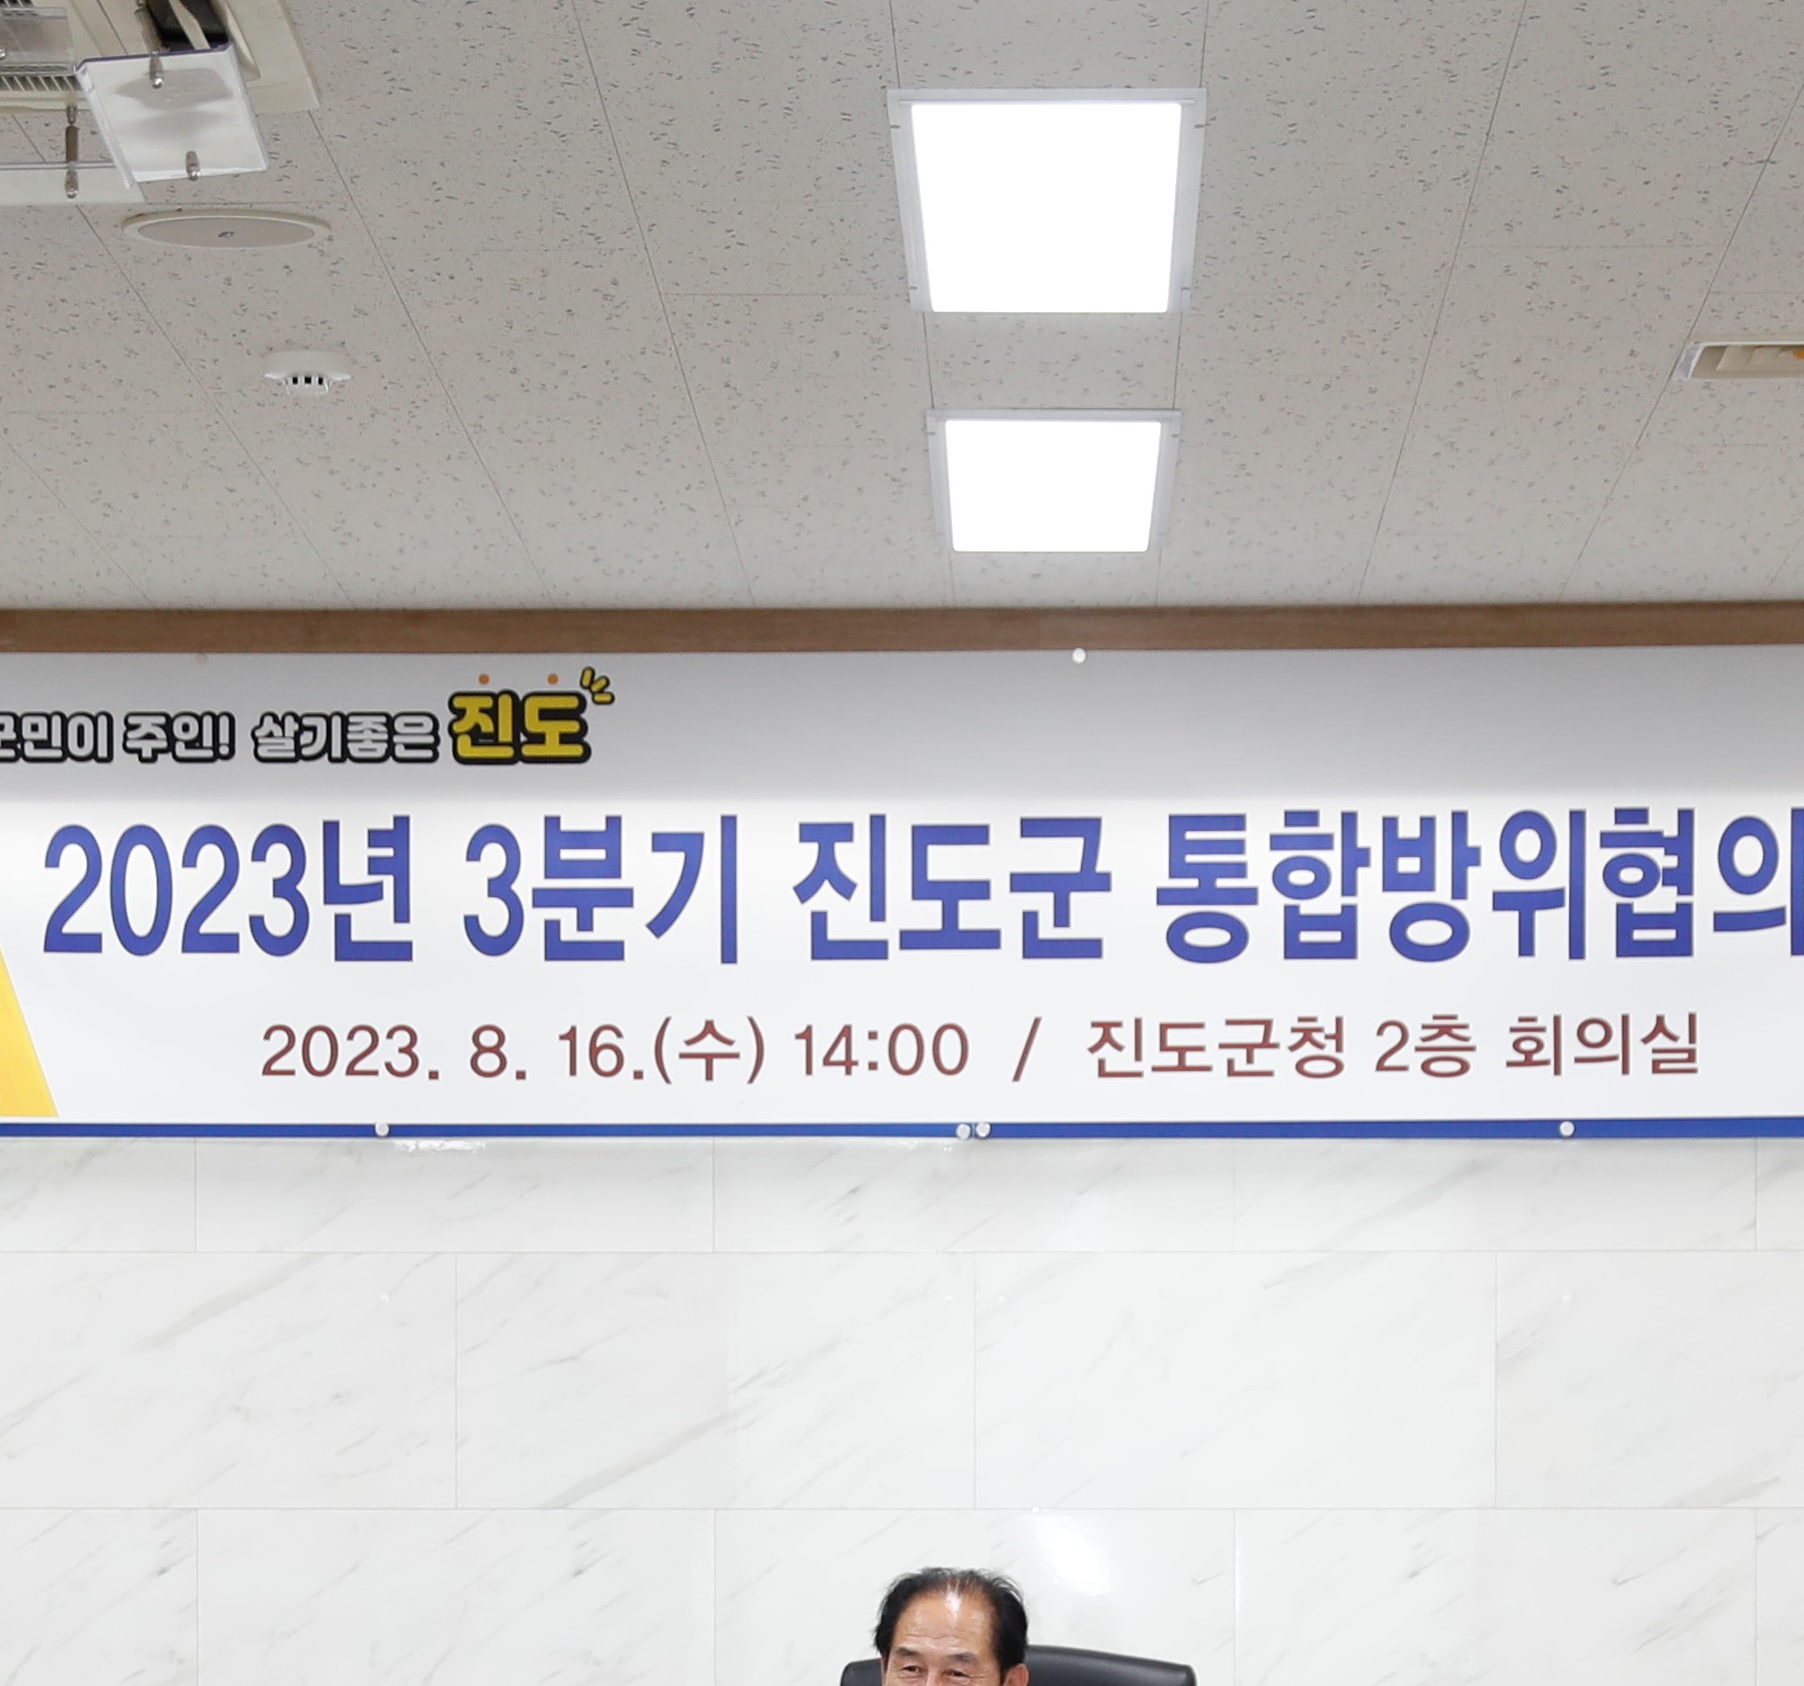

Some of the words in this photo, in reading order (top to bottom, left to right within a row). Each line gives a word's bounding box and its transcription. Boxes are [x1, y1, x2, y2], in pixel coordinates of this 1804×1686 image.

[122, 710, 236, 763] 주인!
[251, 710, 441, 763] 살기좋은
[447, 689, 592, 765] 진도
[42, 814, 414, 963] 2023년
[462, 814, 739, 965] 3분기
[792, 813, 1113, 961] 진도군
[261, 1024, 439, 1081] 2023.
[469, 1024, 527, 1081] 8.
[558, 1015, 765, 1085] 16.(수)
[794, 1022, 970, 1077] 14:00
[1012, 1016, 1042, 1082] /
[1086, 1015, 1346, 1079] 진도군청
[1374, 1014, 1478, 1079] 2층
[1505, 1011, 1700, 1077] 회의실
